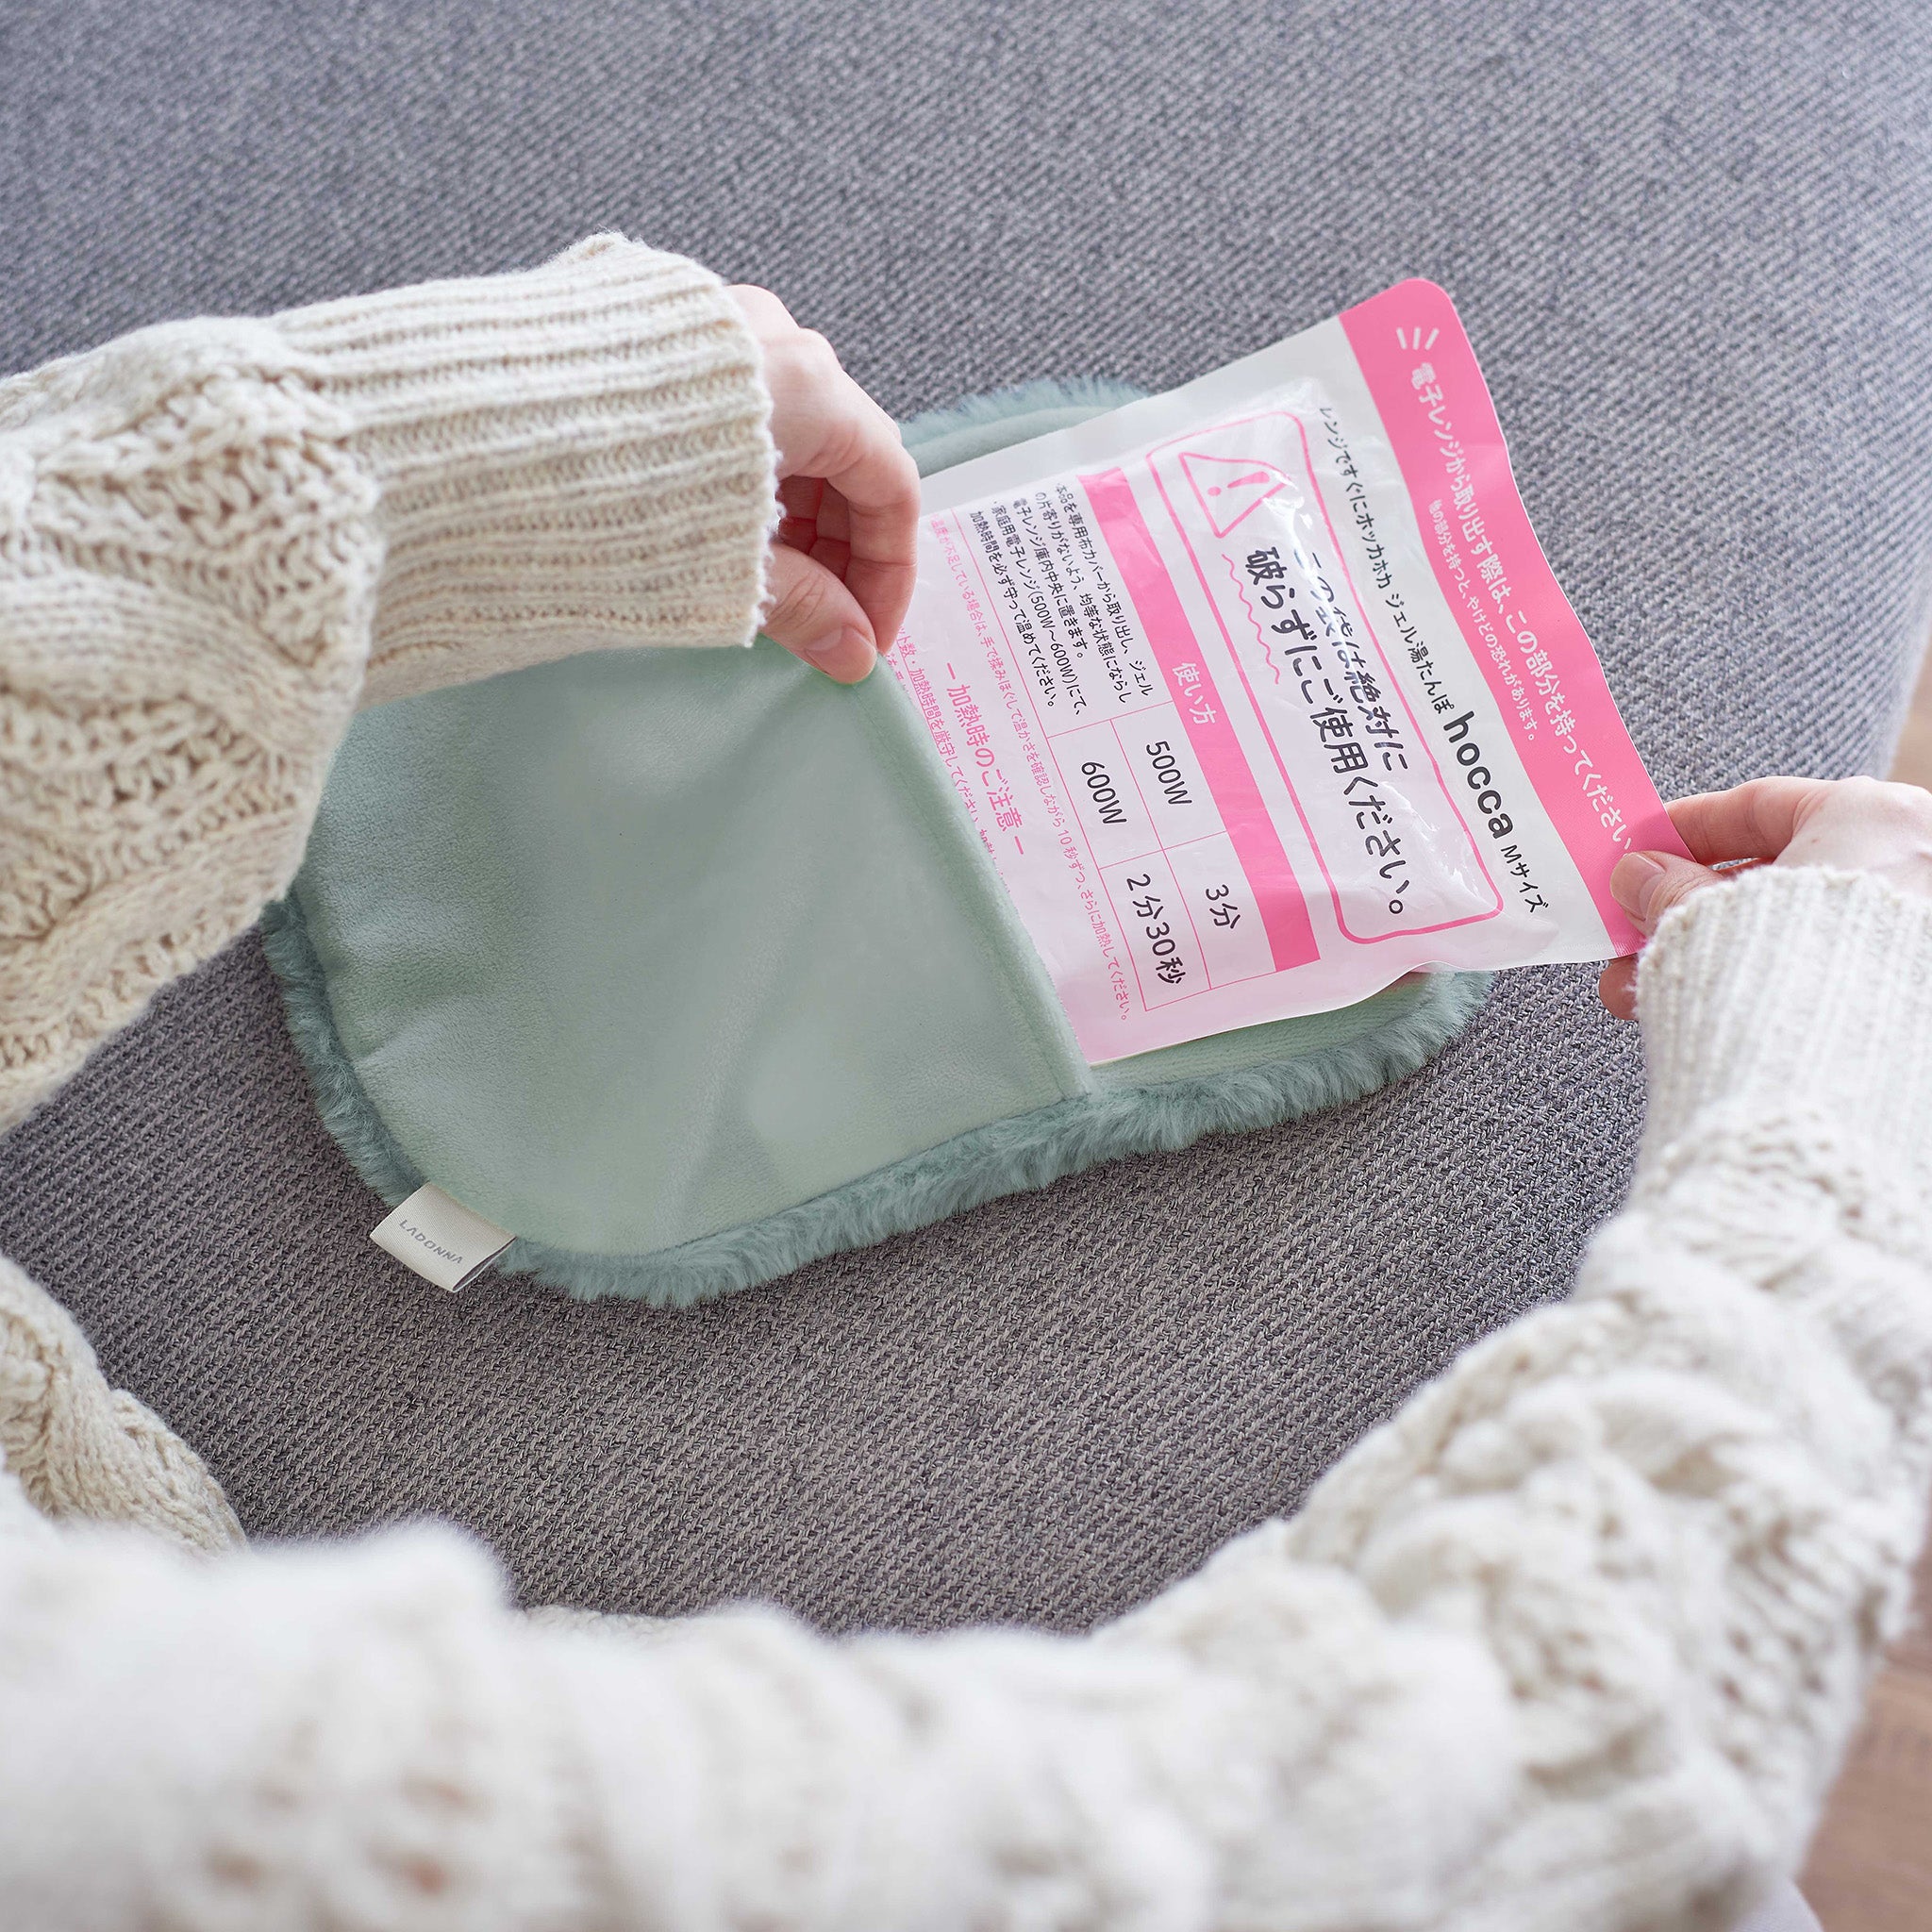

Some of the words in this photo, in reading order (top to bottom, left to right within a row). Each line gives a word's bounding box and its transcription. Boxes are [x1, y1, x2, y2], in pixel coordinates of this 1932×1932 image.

[969, 510, 1056, 707] 加熱時間を必ず守って温めてください。
[1293, 549, 1407, 771] この袋は絶対に
[1410, 361, 1631, 858] 電子レンジから取り出す際は、この部分を持ってください
[1428, 498, 1538, 741] 他の部分を持つと、やけどの恐れがあります。
[1172, 662, 1216, 724] 使い方
[1244, 545, 1409, 914] 破らずにご使用ください。
[1384, 592, 1455, 714] ジェル湯たんぽ
[1442, 709, 1513, 839] hocca
[1500, 843, 1549, 913] Mサイズ
[1080, 761, 1127, 824] 600W
[1145, 740, 1192, 805] 500W
[1125, 873, 1186, 984] 2分30秒
[1205, 883, 1241, 929] 3分
[398, 1219, 464, 1264] LADONNA
